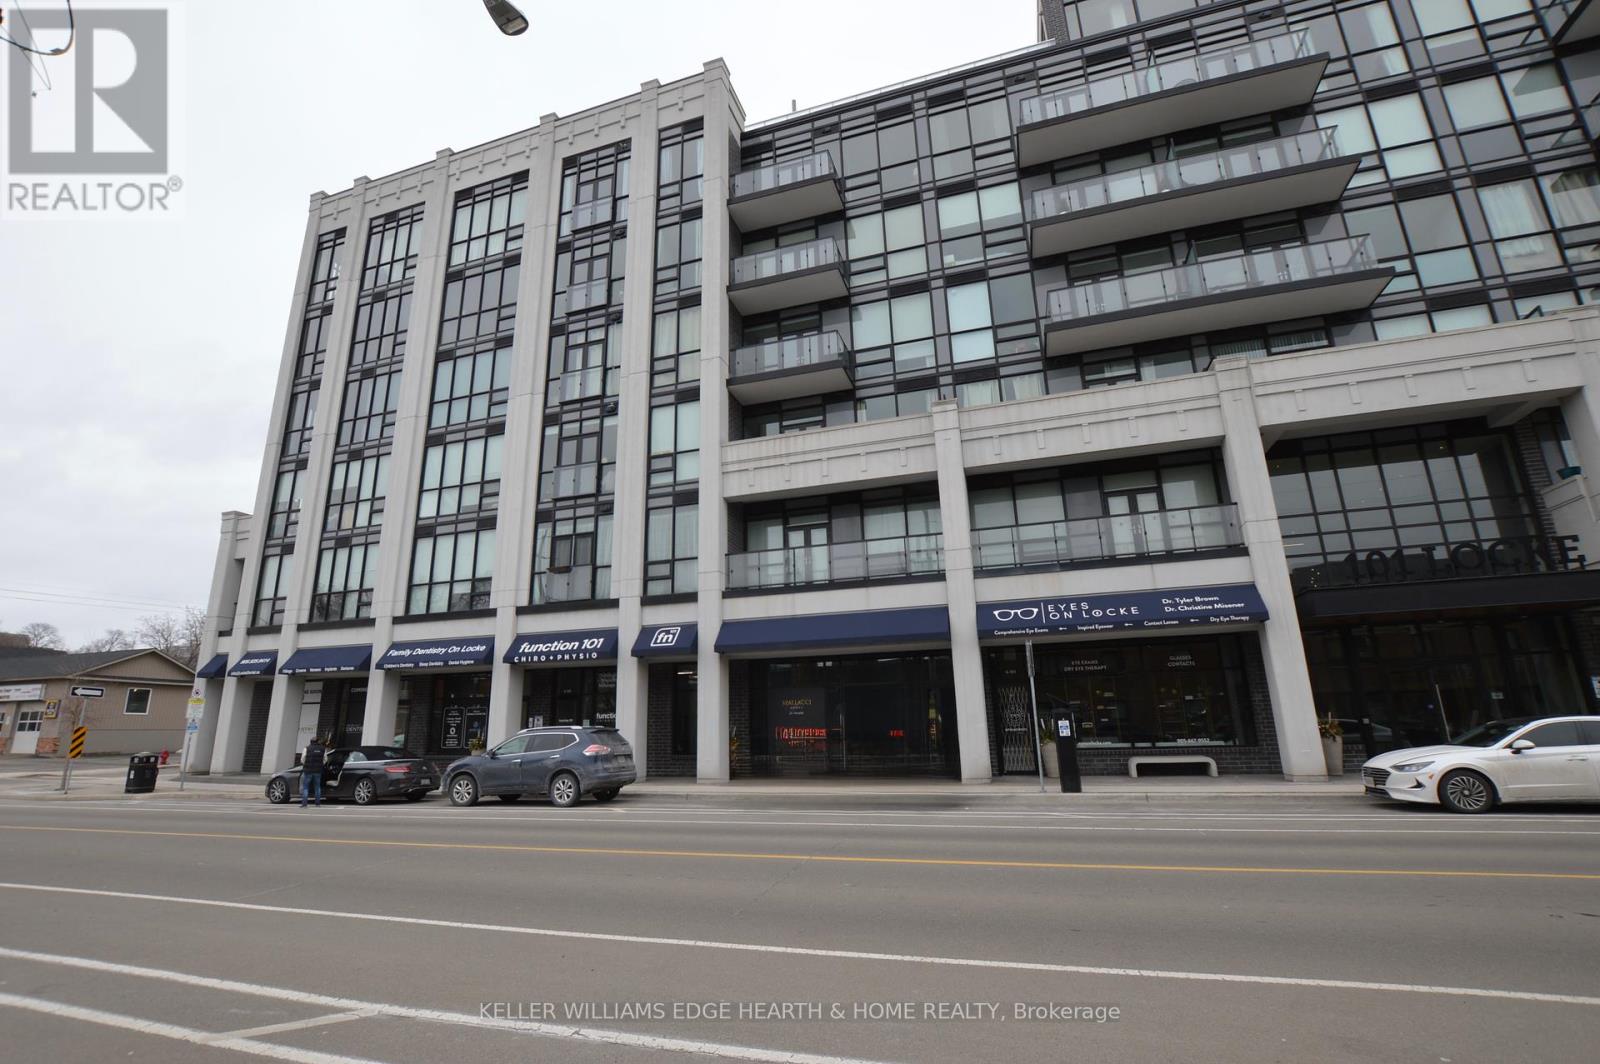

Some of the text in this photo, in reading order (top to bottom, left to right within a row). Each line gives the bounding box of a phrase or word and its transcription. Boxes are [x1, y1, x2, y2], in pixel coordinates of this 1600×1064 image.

[1421, 534, 1587, 577] LOCKE
[1048, 602, 1090, 612] EYES
[1050, 606, 1140, 620] ON LOCKE
[387, 644, 486, 657] Family Dentistry On Locke
[519, 637, 605, 653] function 101
[514, 655, 546, 663] CHIRO
[557, 652, 598, 661] PHYSIO
